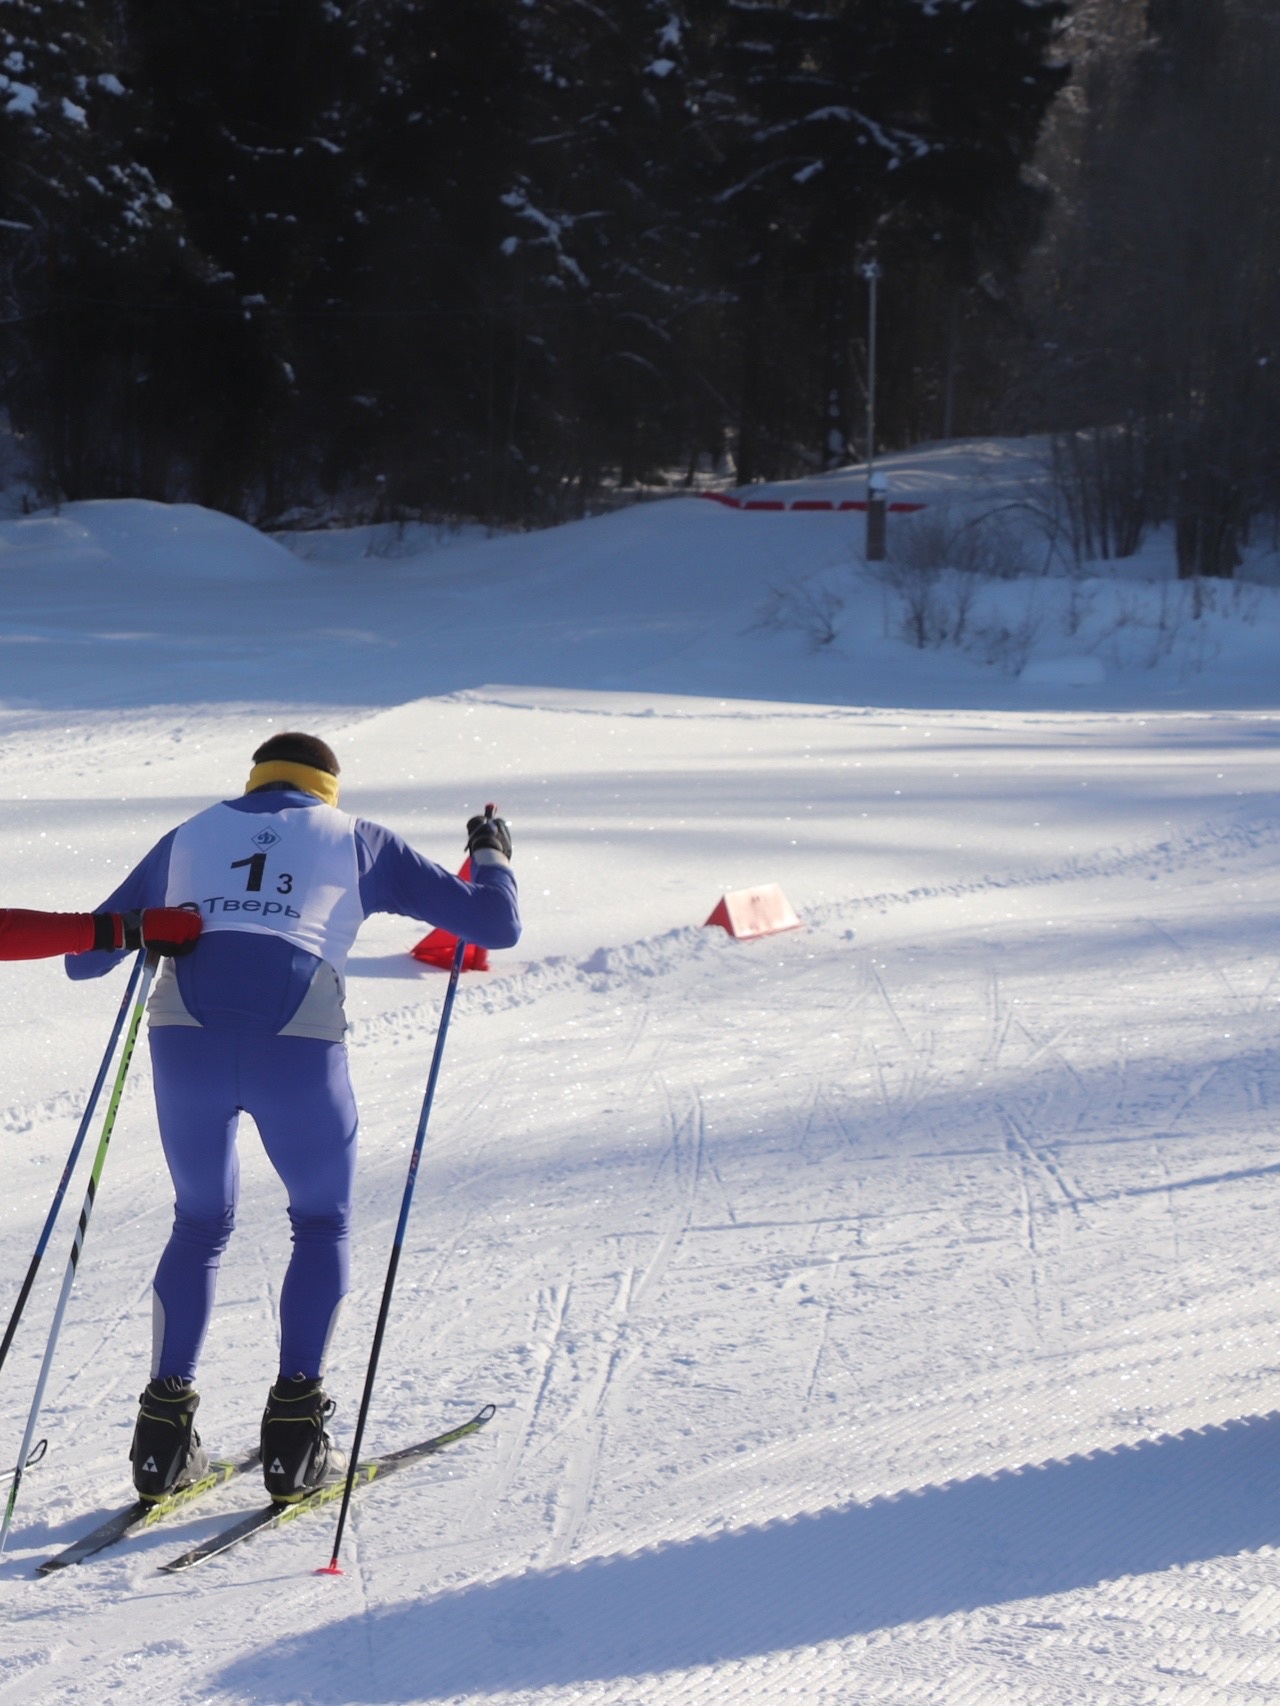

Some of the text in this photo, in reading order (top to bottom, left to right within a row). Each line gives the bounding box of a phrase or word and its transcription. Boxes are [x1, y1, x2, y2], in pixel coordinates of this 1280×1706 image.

[230, 853, 293, 894] 1 3
[202, 896, 302, 919] Тверь
